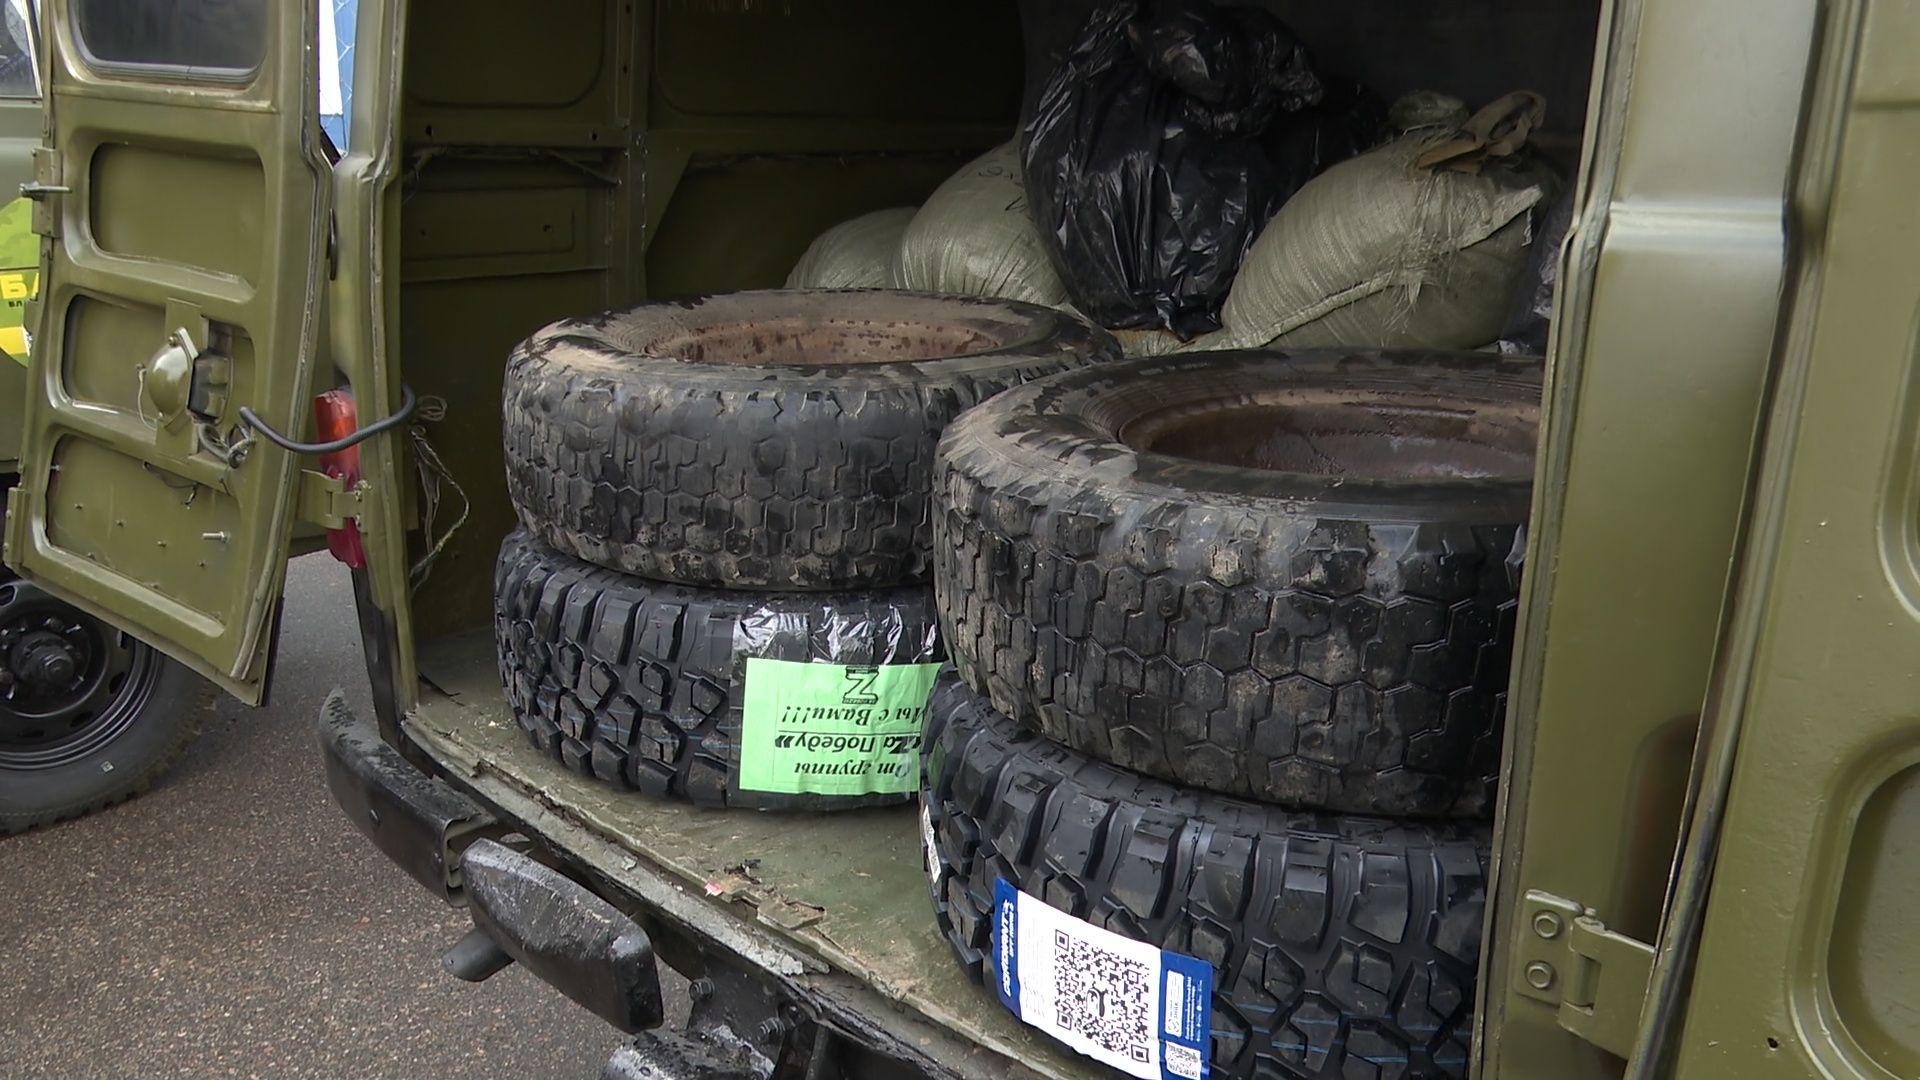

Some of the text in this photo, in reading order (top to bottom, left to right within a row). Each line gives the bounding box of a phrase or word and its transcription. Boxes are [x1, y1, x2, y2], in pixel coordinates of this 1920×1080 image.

[781, 706, 870, 726] Вами!!!
[775, 732, 875, 753] Победу»
[794, 759, 871, 778] группы
[1001, 912, 1011, 997] CORDIANT
